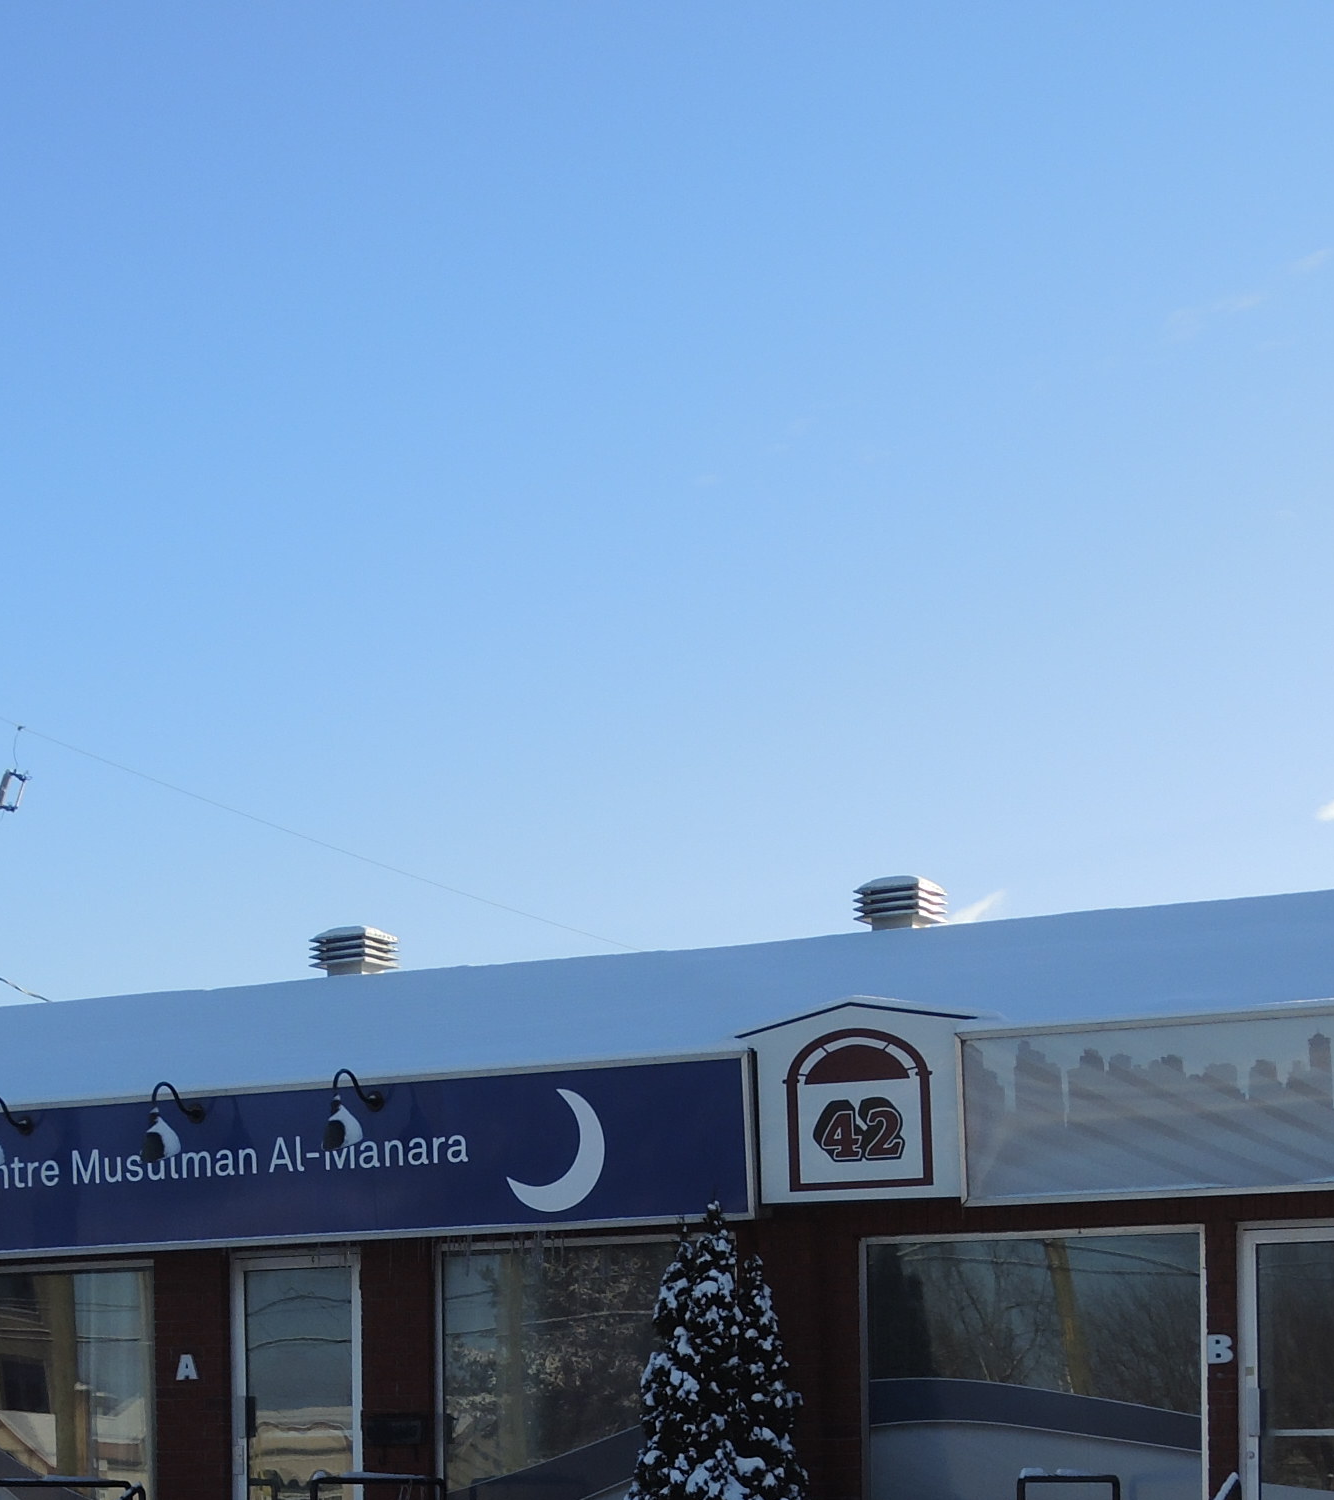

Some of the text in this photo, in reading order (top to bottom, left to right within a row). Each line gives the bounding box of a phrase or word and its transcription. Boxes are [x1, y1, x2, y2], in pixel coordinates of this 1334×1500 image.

[813, 1096, 906, 1162] 42
[71, 1147, 258, 1185] Musulman
[269, 1133, 469, 1173] Al-Manara
[176, 1354, 199, 1381] A
[1207, 1334, 1234, 1364] B
